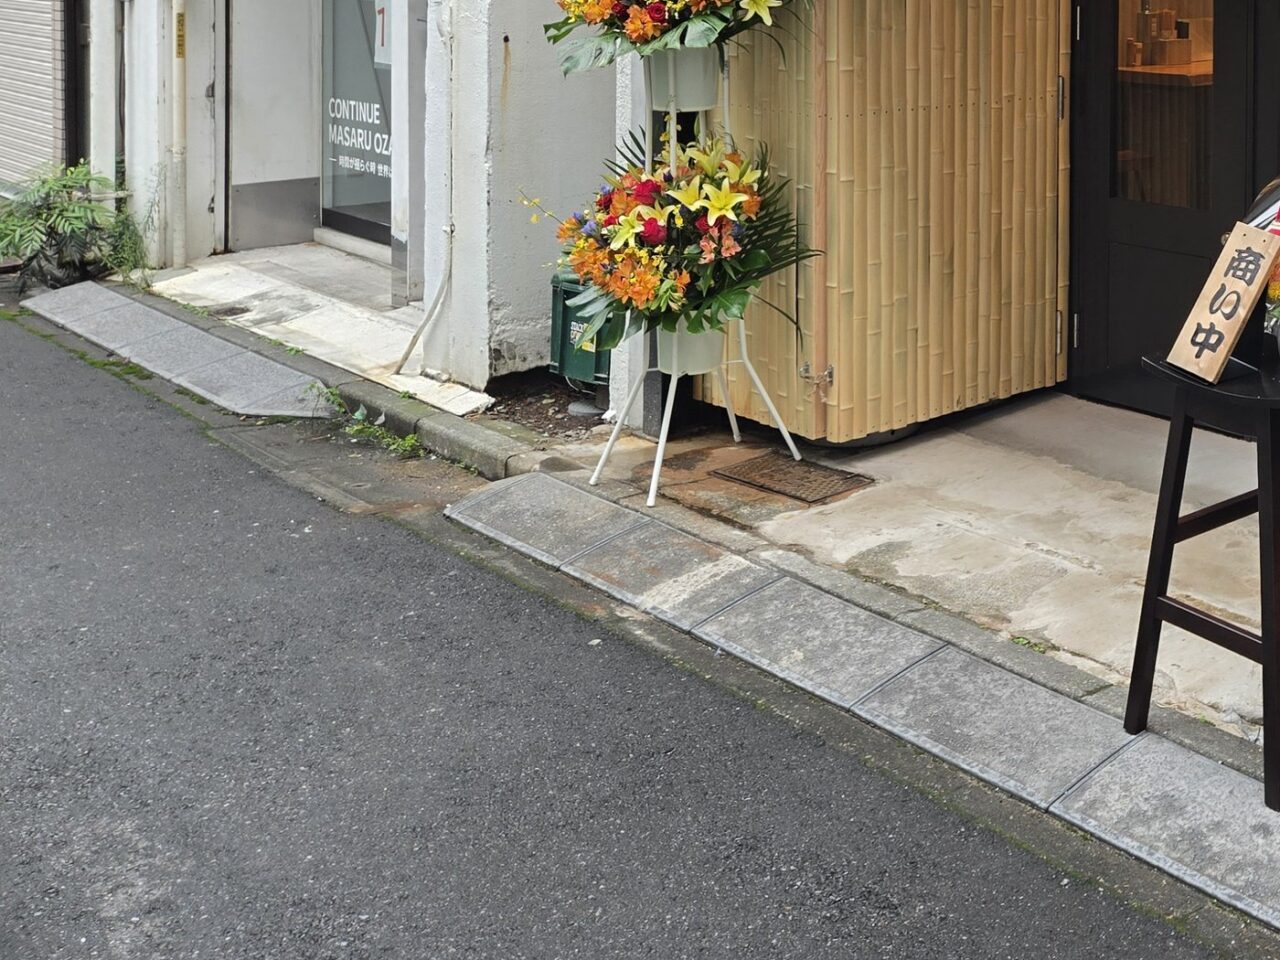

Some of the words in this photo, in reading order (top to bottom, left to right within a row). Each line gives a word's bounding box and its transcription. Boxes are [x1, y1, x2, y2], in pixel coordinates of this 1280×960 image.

[377, 7, 385, 47] 1
[328, 97, 381, 125] CONTINUE
[328, 123, 372, 151] MASARU
[1190, 246, 1266, 359] 商い中
